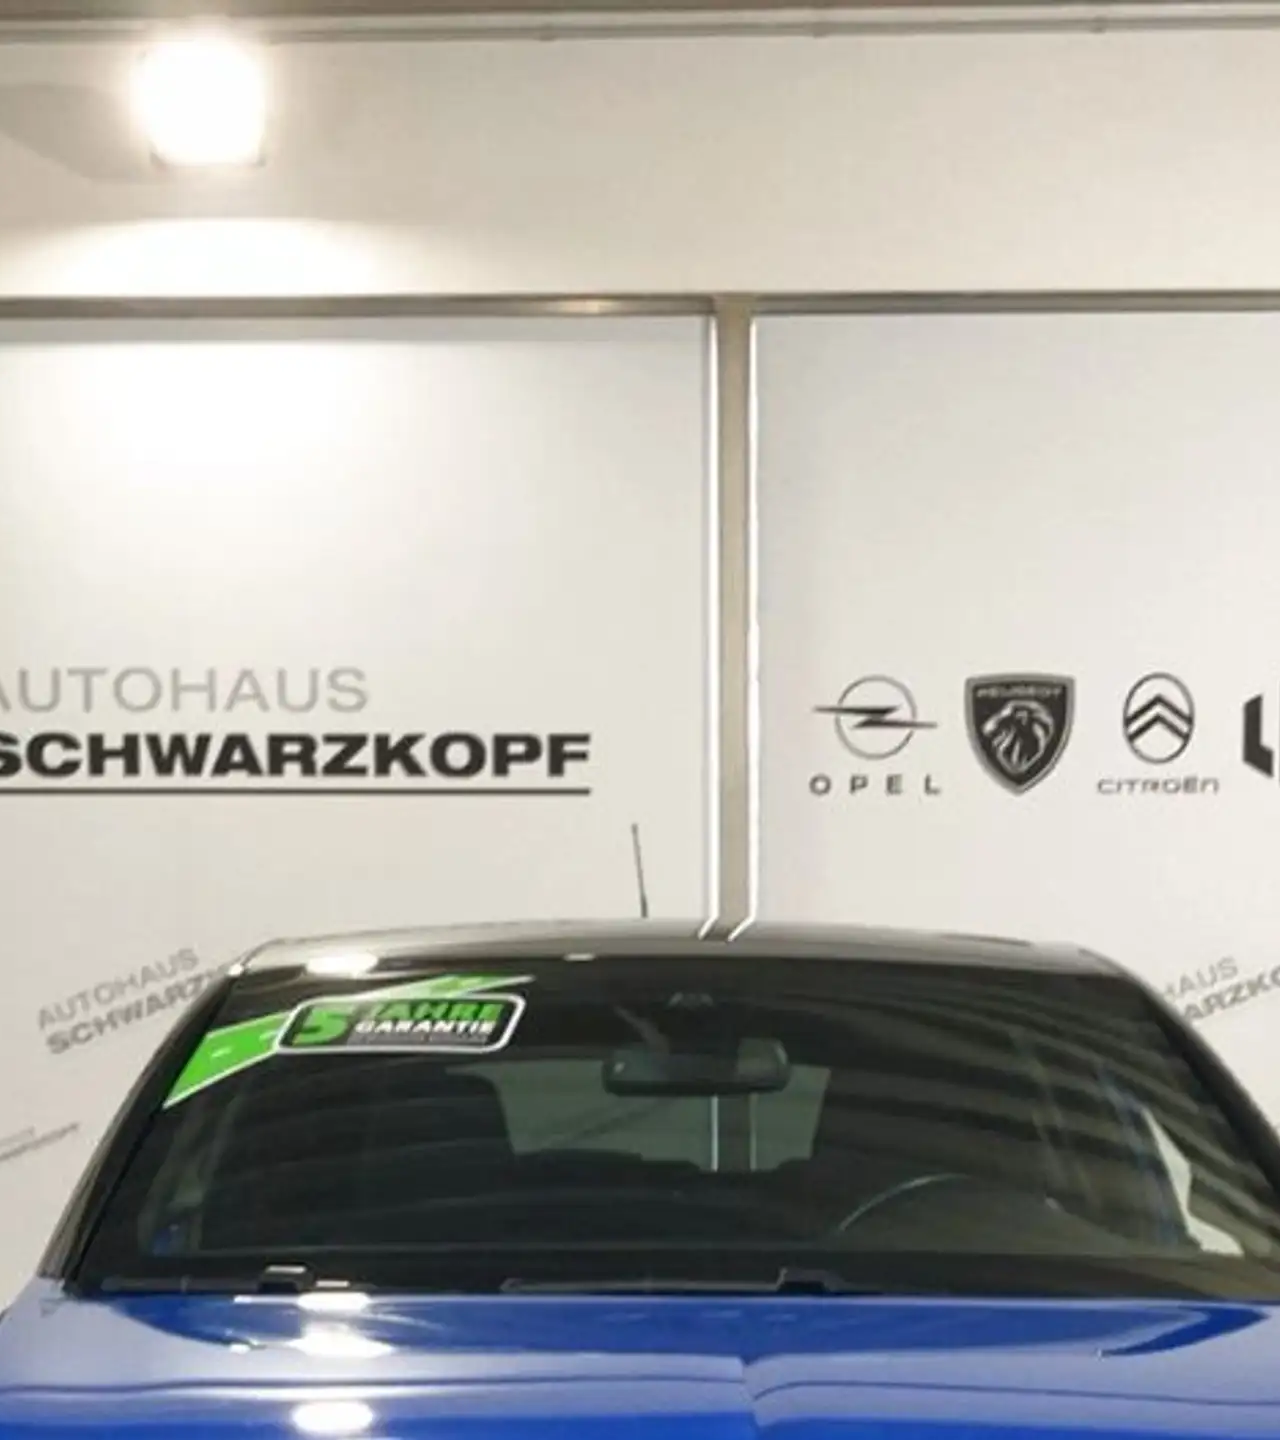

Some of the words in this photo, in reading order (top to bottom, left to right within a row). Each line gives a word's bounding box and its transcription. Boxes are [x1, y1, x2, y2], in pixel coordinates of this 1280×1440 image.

[808, 773, 942, 796] OPEL
[38, 948, 199, 1031] AUTOHAUS
[46, 969, 216, 1055] SCHWARZ
[354, 1019, 498, 1034] GARANTIE
